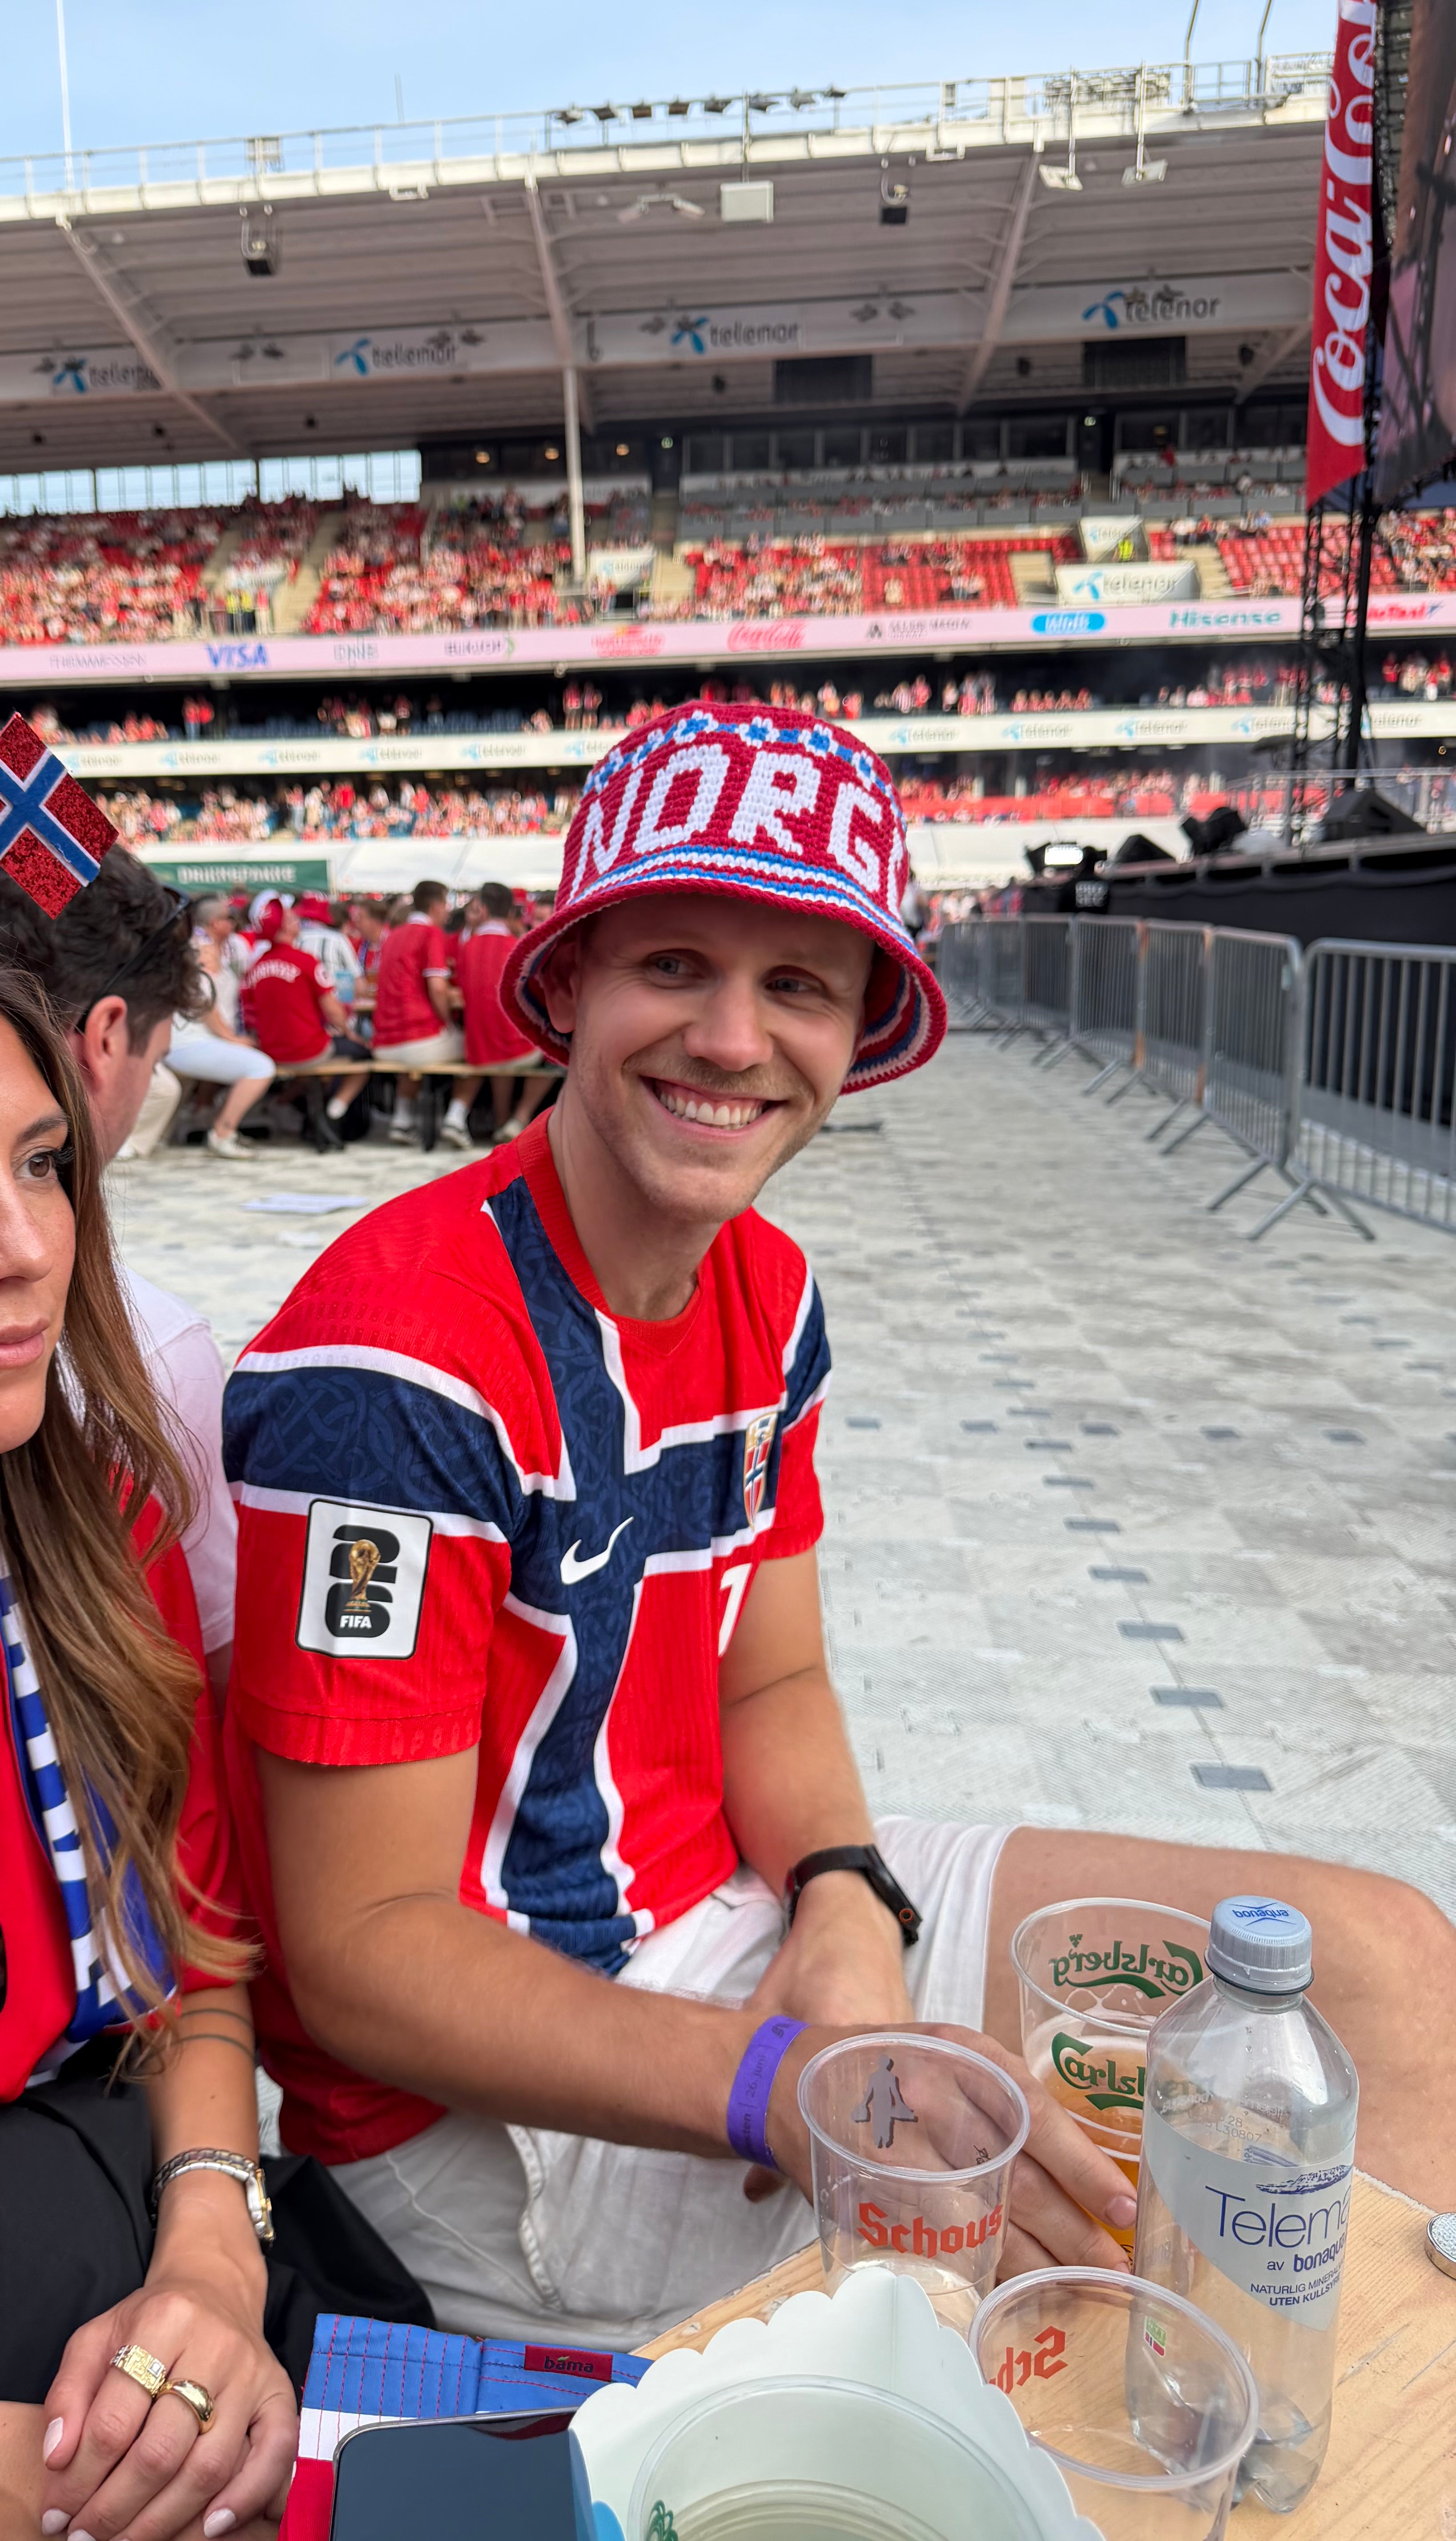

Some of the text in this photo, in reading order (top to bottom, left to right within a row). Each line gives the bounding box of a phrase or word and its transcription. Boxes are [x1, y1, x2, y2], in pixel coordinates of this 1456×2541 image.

[1170, 609, 1281, 629] Hisense
[206, 643, 269, 667] VISA
[339, 1615, 372, 1629] FIFA
[1232, 1909, 1289, 1918] bonaqua
[1051, 2032, 1146, 2097] Carls
[857, 2202, 1003, 2259] Schous
[1267, 2261, 1284, 2271] av
[1251, 2283, 1306, 2294] NATURLIG
[1270, 2296, 1300, 2306] UTEN
[544, 2356, 594, 2373] bama
